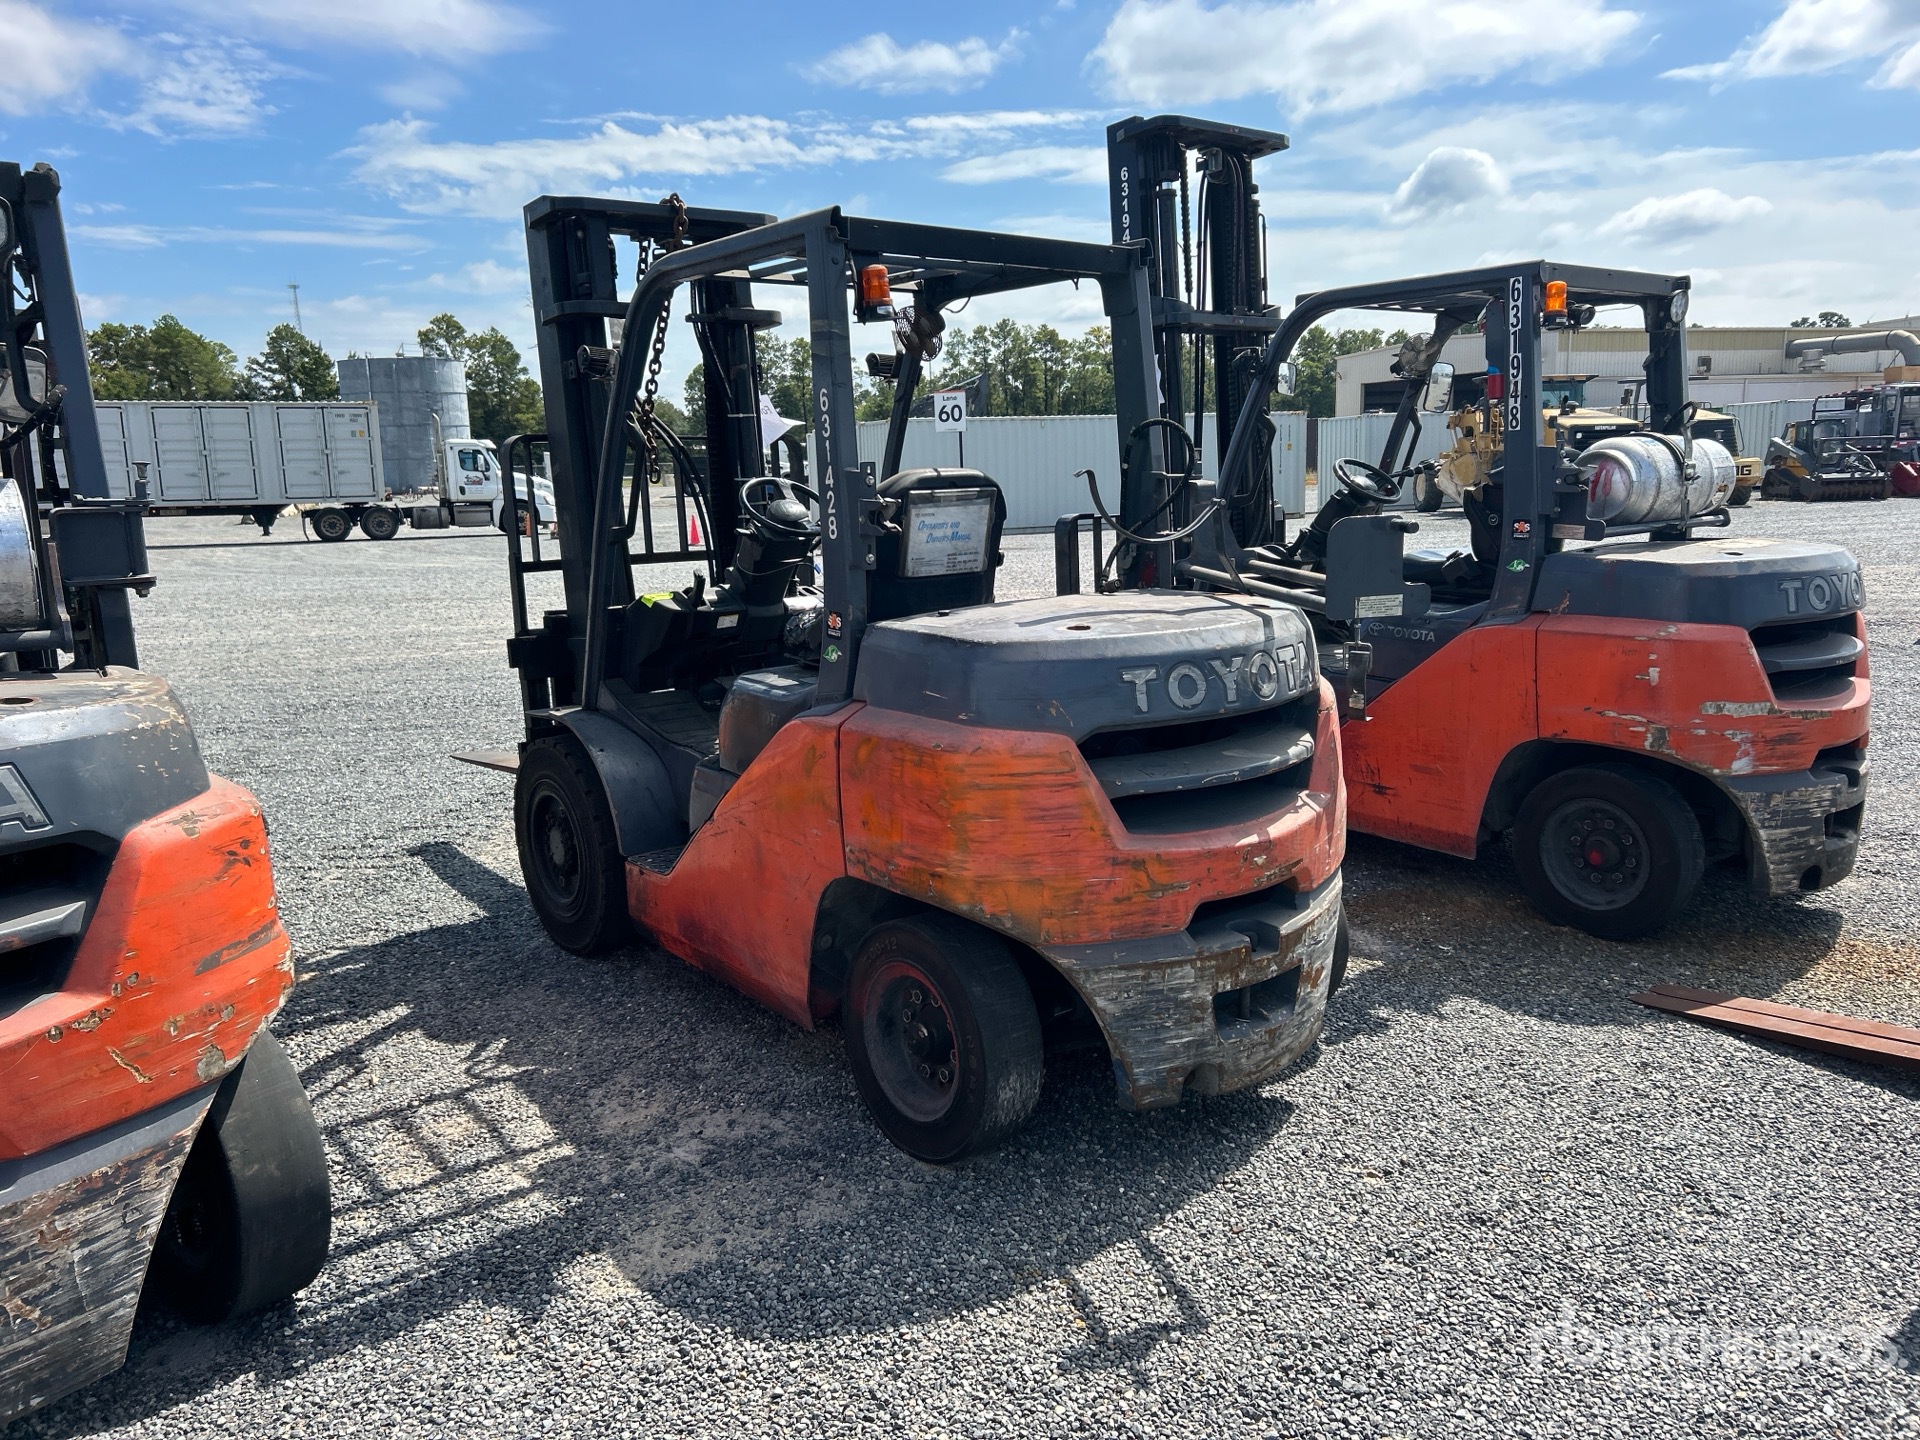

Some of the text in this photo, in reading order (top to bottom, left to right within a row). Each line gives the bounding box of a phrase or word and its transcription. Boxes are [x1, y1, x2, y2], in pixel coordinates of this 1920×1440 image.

[1120, 166, 1131, 243] 63194
[1509, 277, 1522, 430] 631948
[938, 404, 963, 422] 60
[819, 387, 838, 540] 631428
[1387, 625, 1436, 643] TOYOTA
[1120, 641, 1313, 714] TOYOTA
